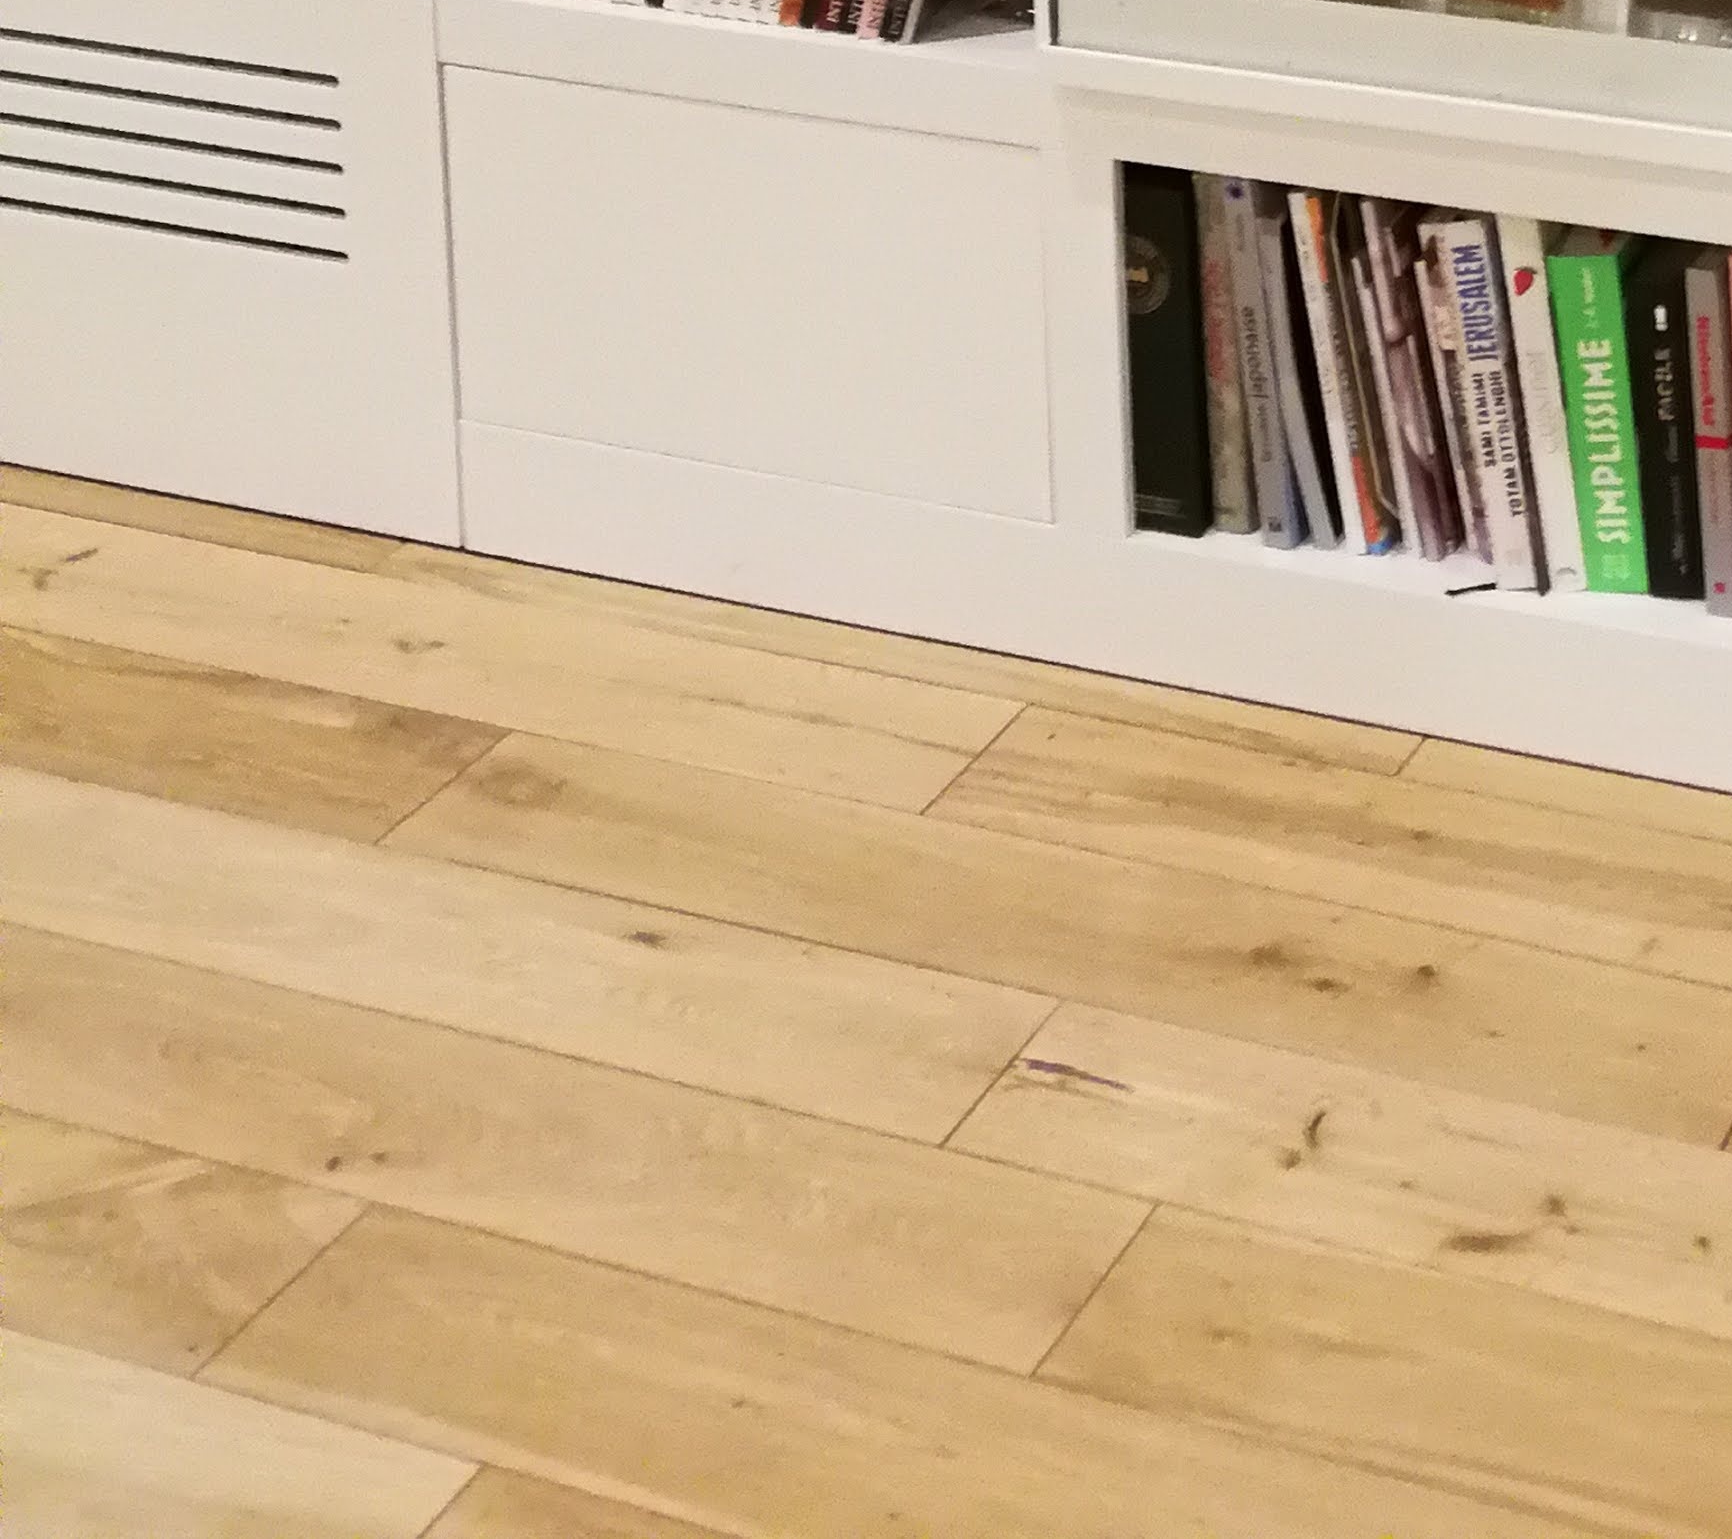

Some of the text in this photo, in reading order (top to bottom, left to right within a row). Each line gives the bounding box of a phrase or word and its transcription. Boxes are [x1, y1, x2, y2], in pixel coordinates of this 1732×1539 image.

[1452, 243, 1499, 363] JERUSALEM
[1481, 429, 1500, 468] SAMI
[1576, 338, 1632, 545] SIMPLISSIME
